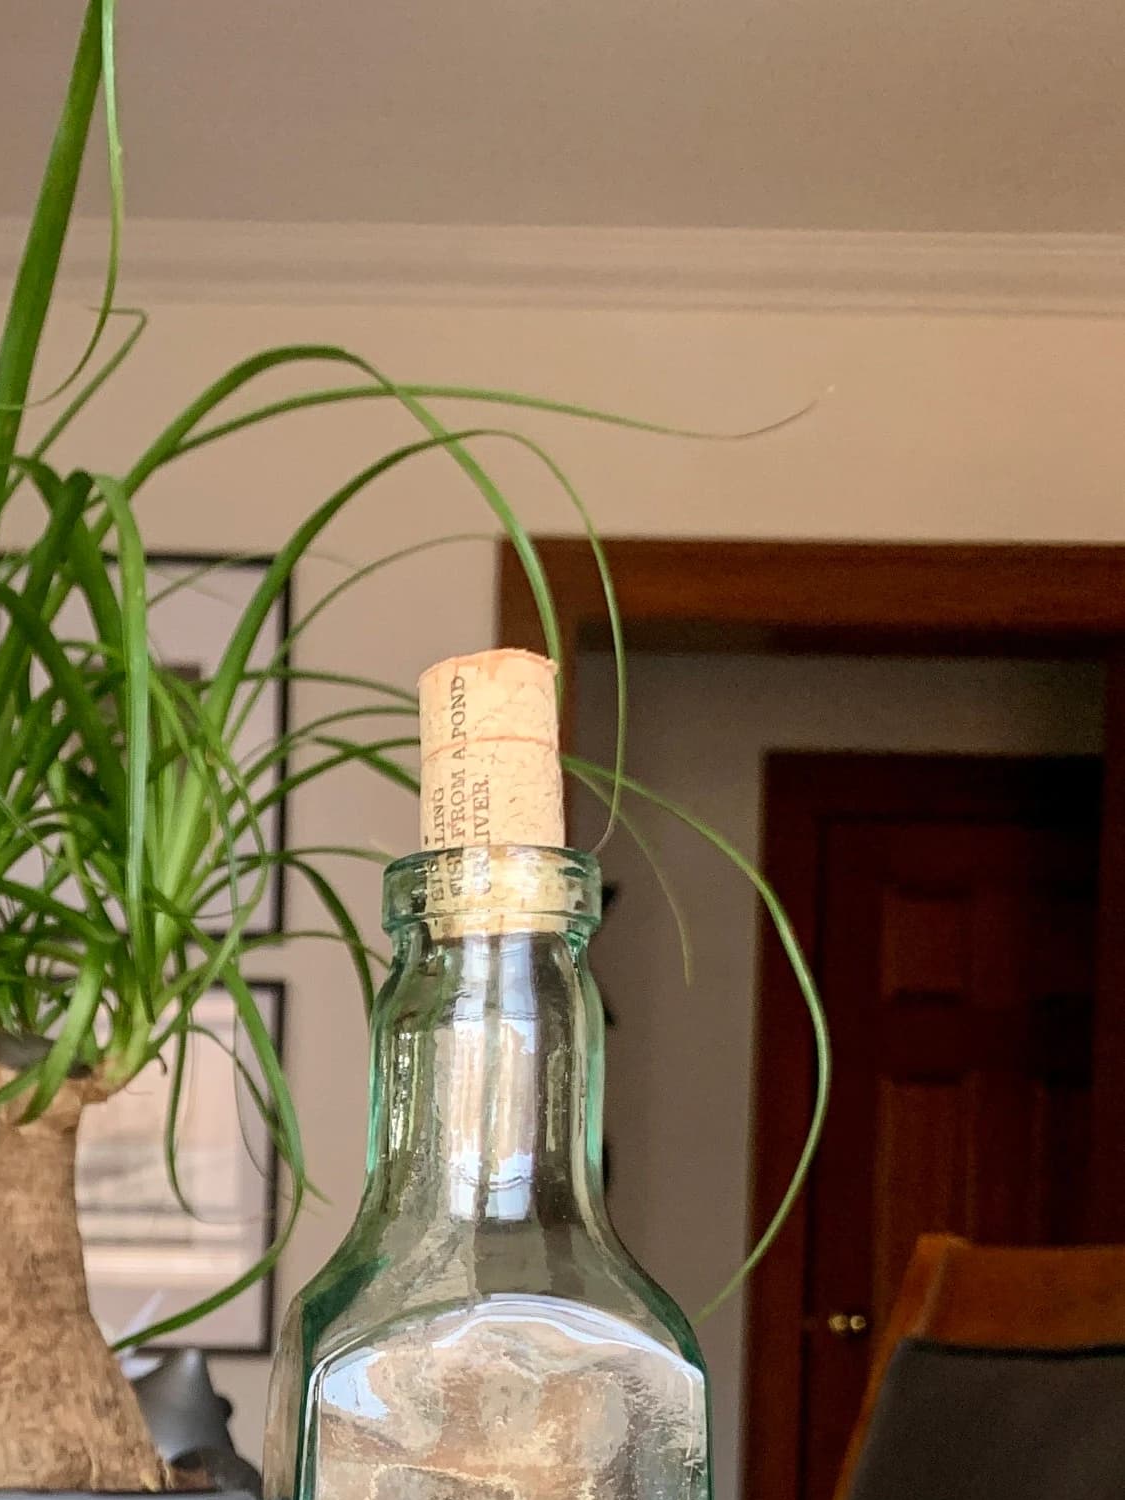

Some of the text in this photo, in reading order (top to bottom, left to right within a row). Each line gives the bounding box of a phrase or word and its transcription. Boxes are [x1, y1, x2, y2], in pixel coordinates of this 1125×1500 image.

[450, 675, 467, 740] POND
[452, 746, 467, 760] A
[450, 768, 466, 839] FROM
